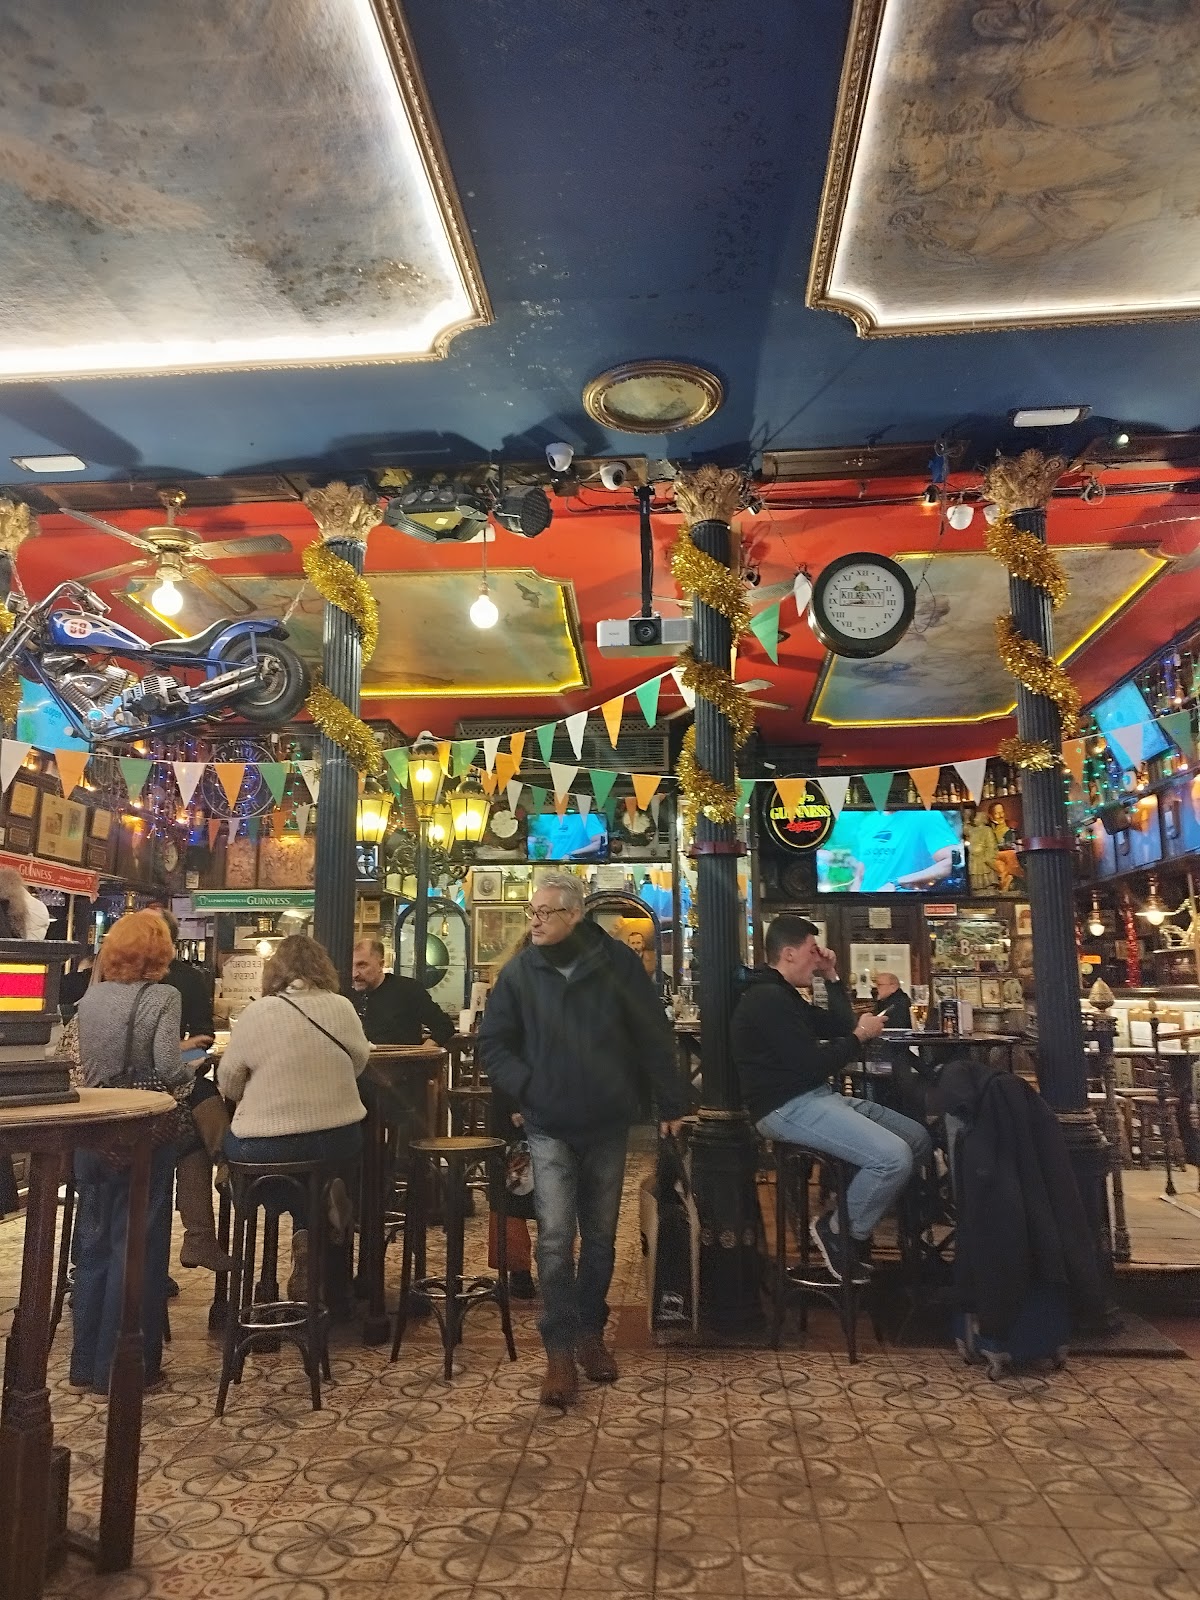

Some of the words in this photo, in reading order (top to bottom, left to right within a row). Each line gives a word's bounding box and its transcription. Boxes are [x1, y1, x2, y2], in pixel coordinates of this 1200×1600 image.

[841, 591, 883, 600] KILKENNY
[19, 863, 53, 881] GUINNESS
[246, 895, 291, 905] GUINNESS
